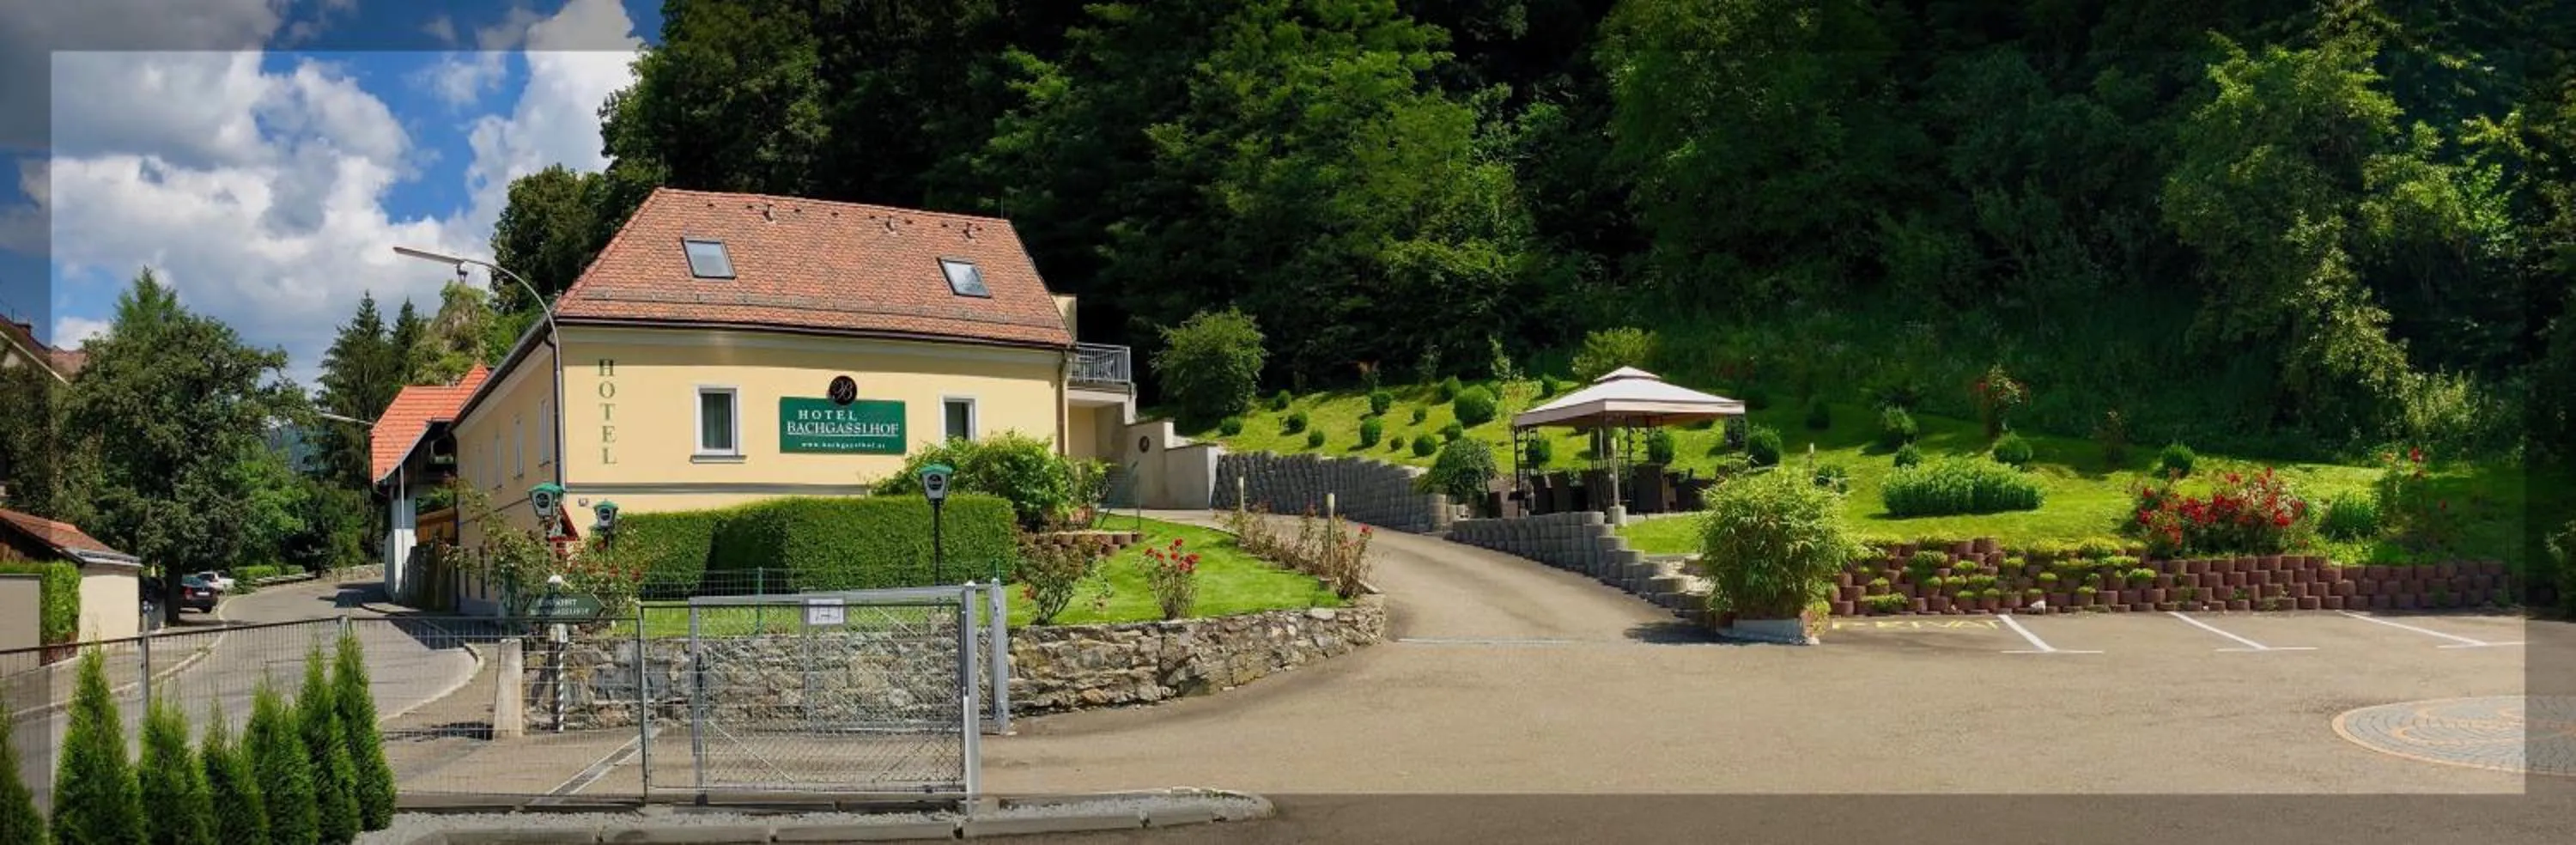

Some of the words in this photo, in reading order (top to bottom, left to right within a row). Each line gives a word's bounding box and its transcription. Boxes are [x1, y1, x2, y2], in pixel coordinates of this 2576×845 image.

[598, 359, 617, 465] HOTEL
[798, 410, 858, 422] HOTEL
[787, 421, 899, 435] BACHGASSLHOF
